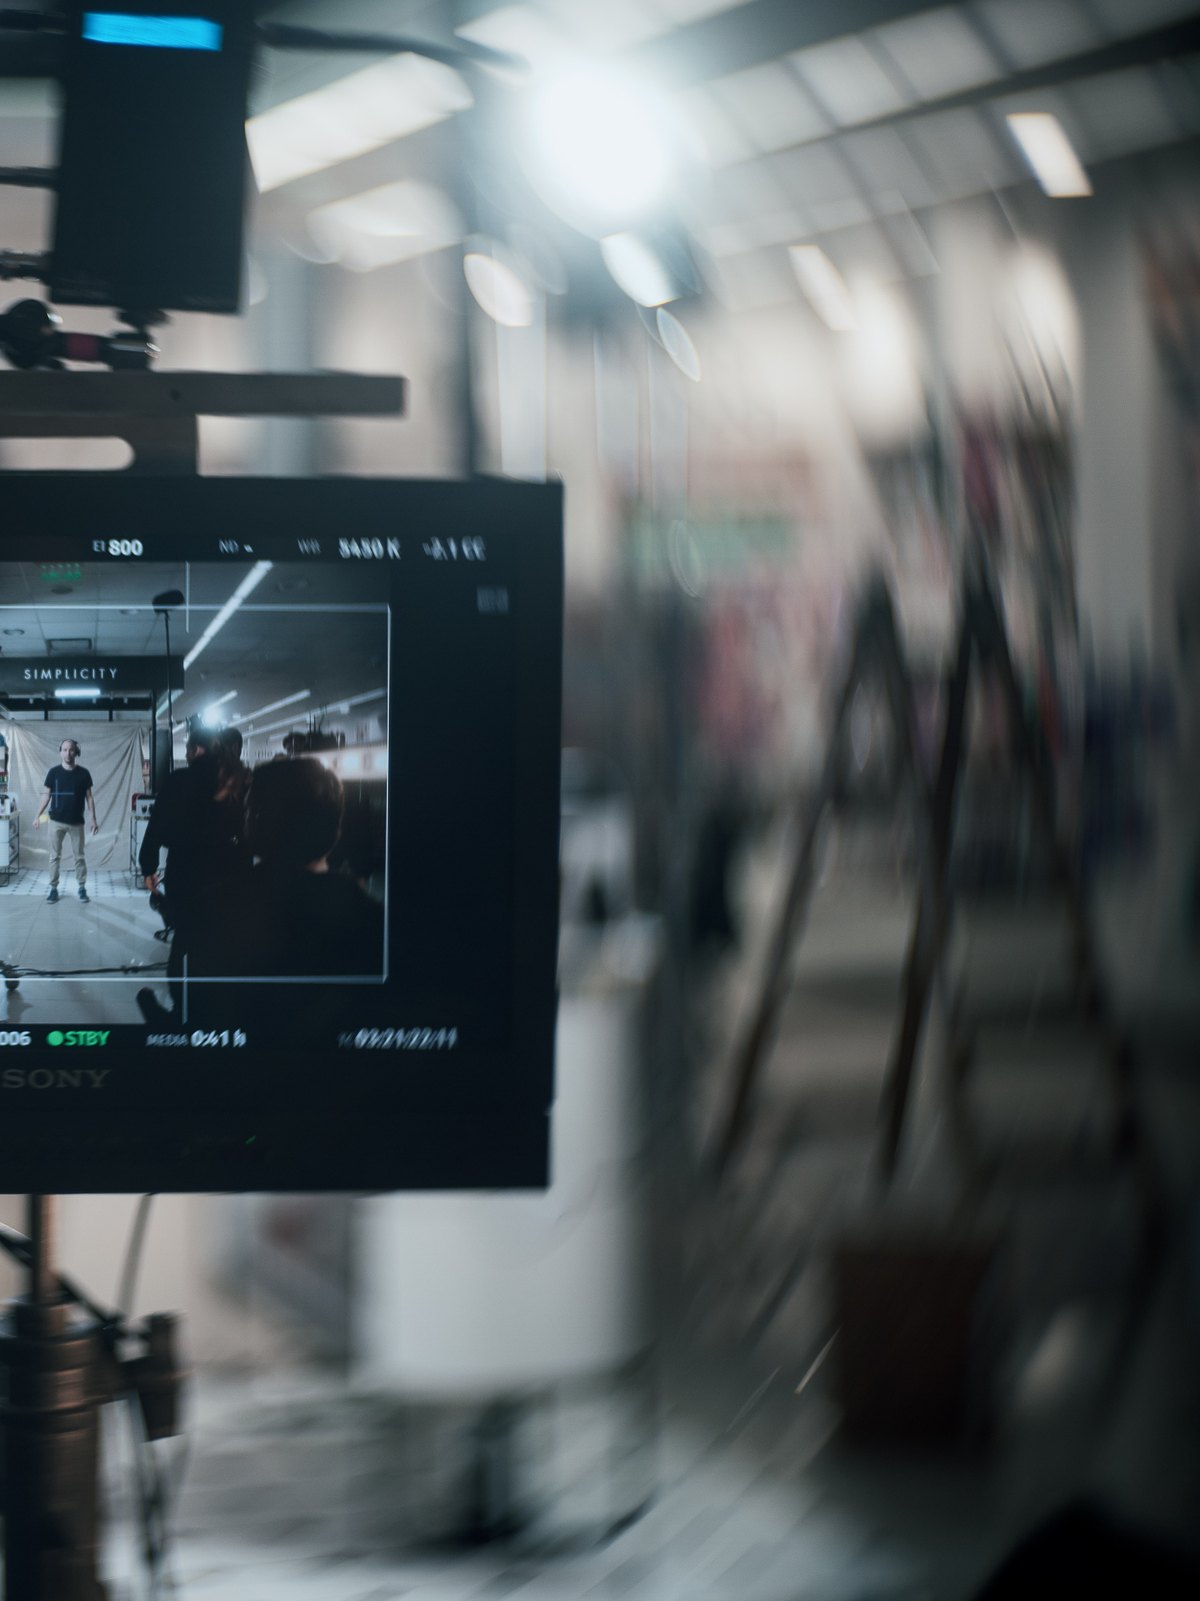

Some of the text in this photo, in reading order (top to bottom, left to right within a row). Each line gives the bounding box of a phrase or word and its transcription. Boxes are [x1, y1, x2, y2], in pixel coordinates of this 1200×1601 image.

[108, 539, 143, 556] 800
[24, 668, 117, 680] SIMPLICITY
[64, 1030, 110, 1046] STBY
[2, 1069, 108, 1088] SONY
